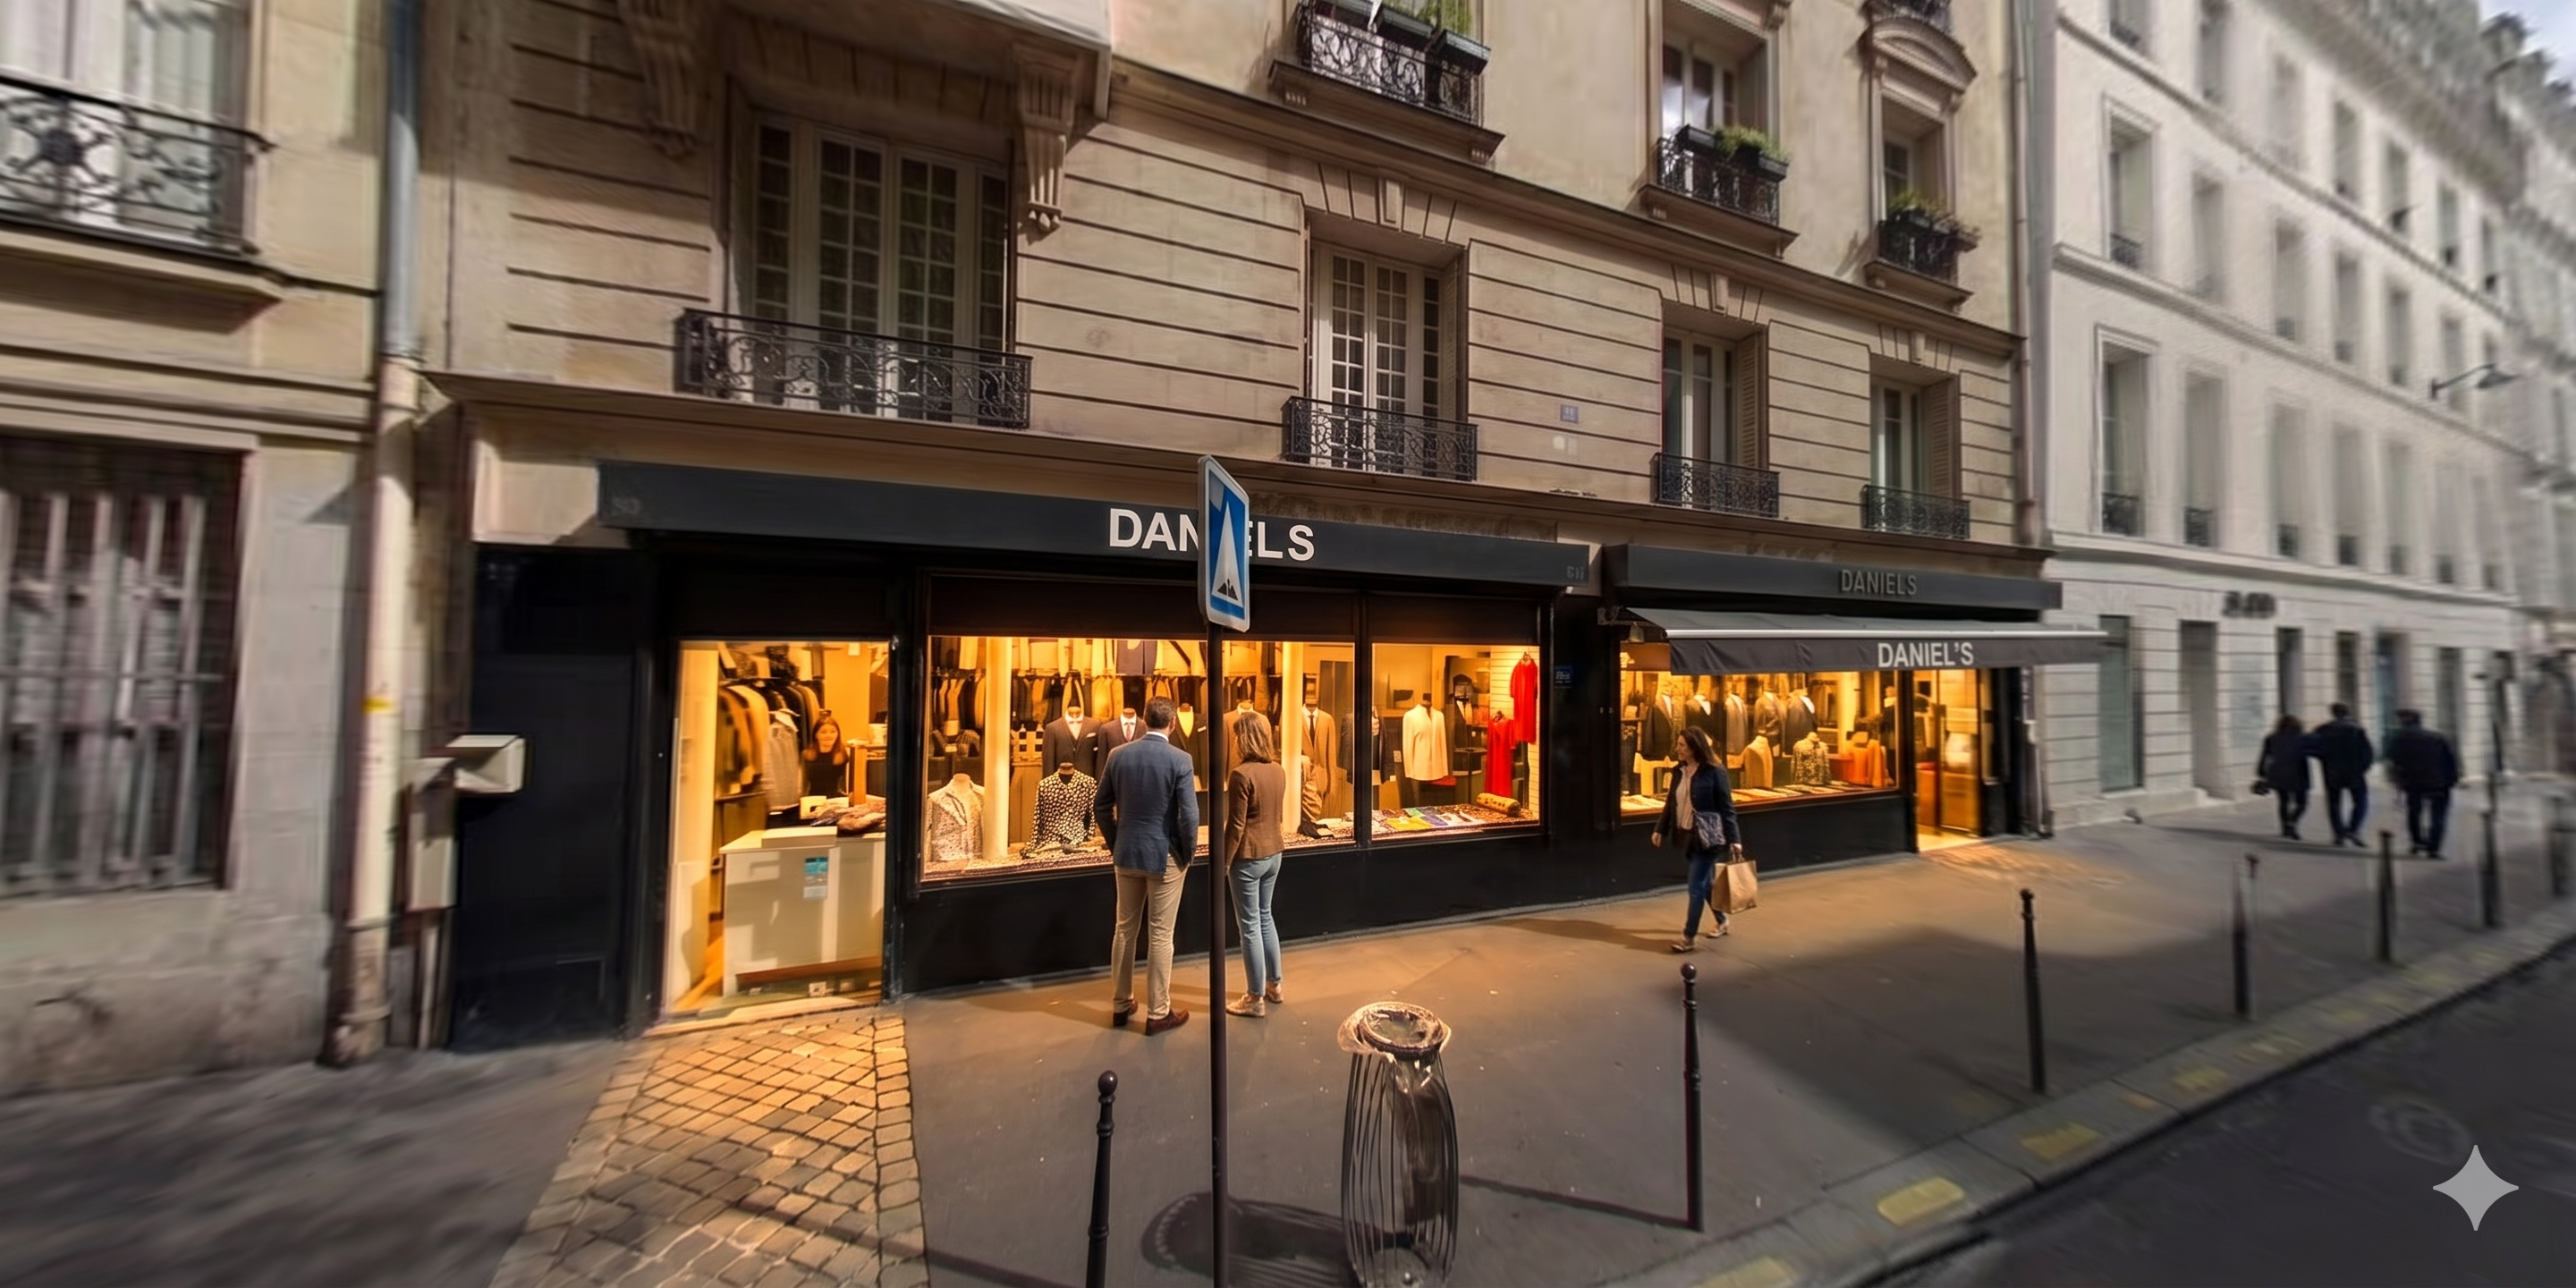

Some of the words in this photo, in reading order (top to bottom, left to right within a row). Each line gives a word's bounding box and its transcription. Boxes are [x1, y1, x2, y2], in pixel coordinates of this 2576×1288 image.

[1109, 508, 1315, 562] DANLS
[1840, 569, 1918, 596] DANIELS
[1877, 641, 1975, 668] DANIEL'S
